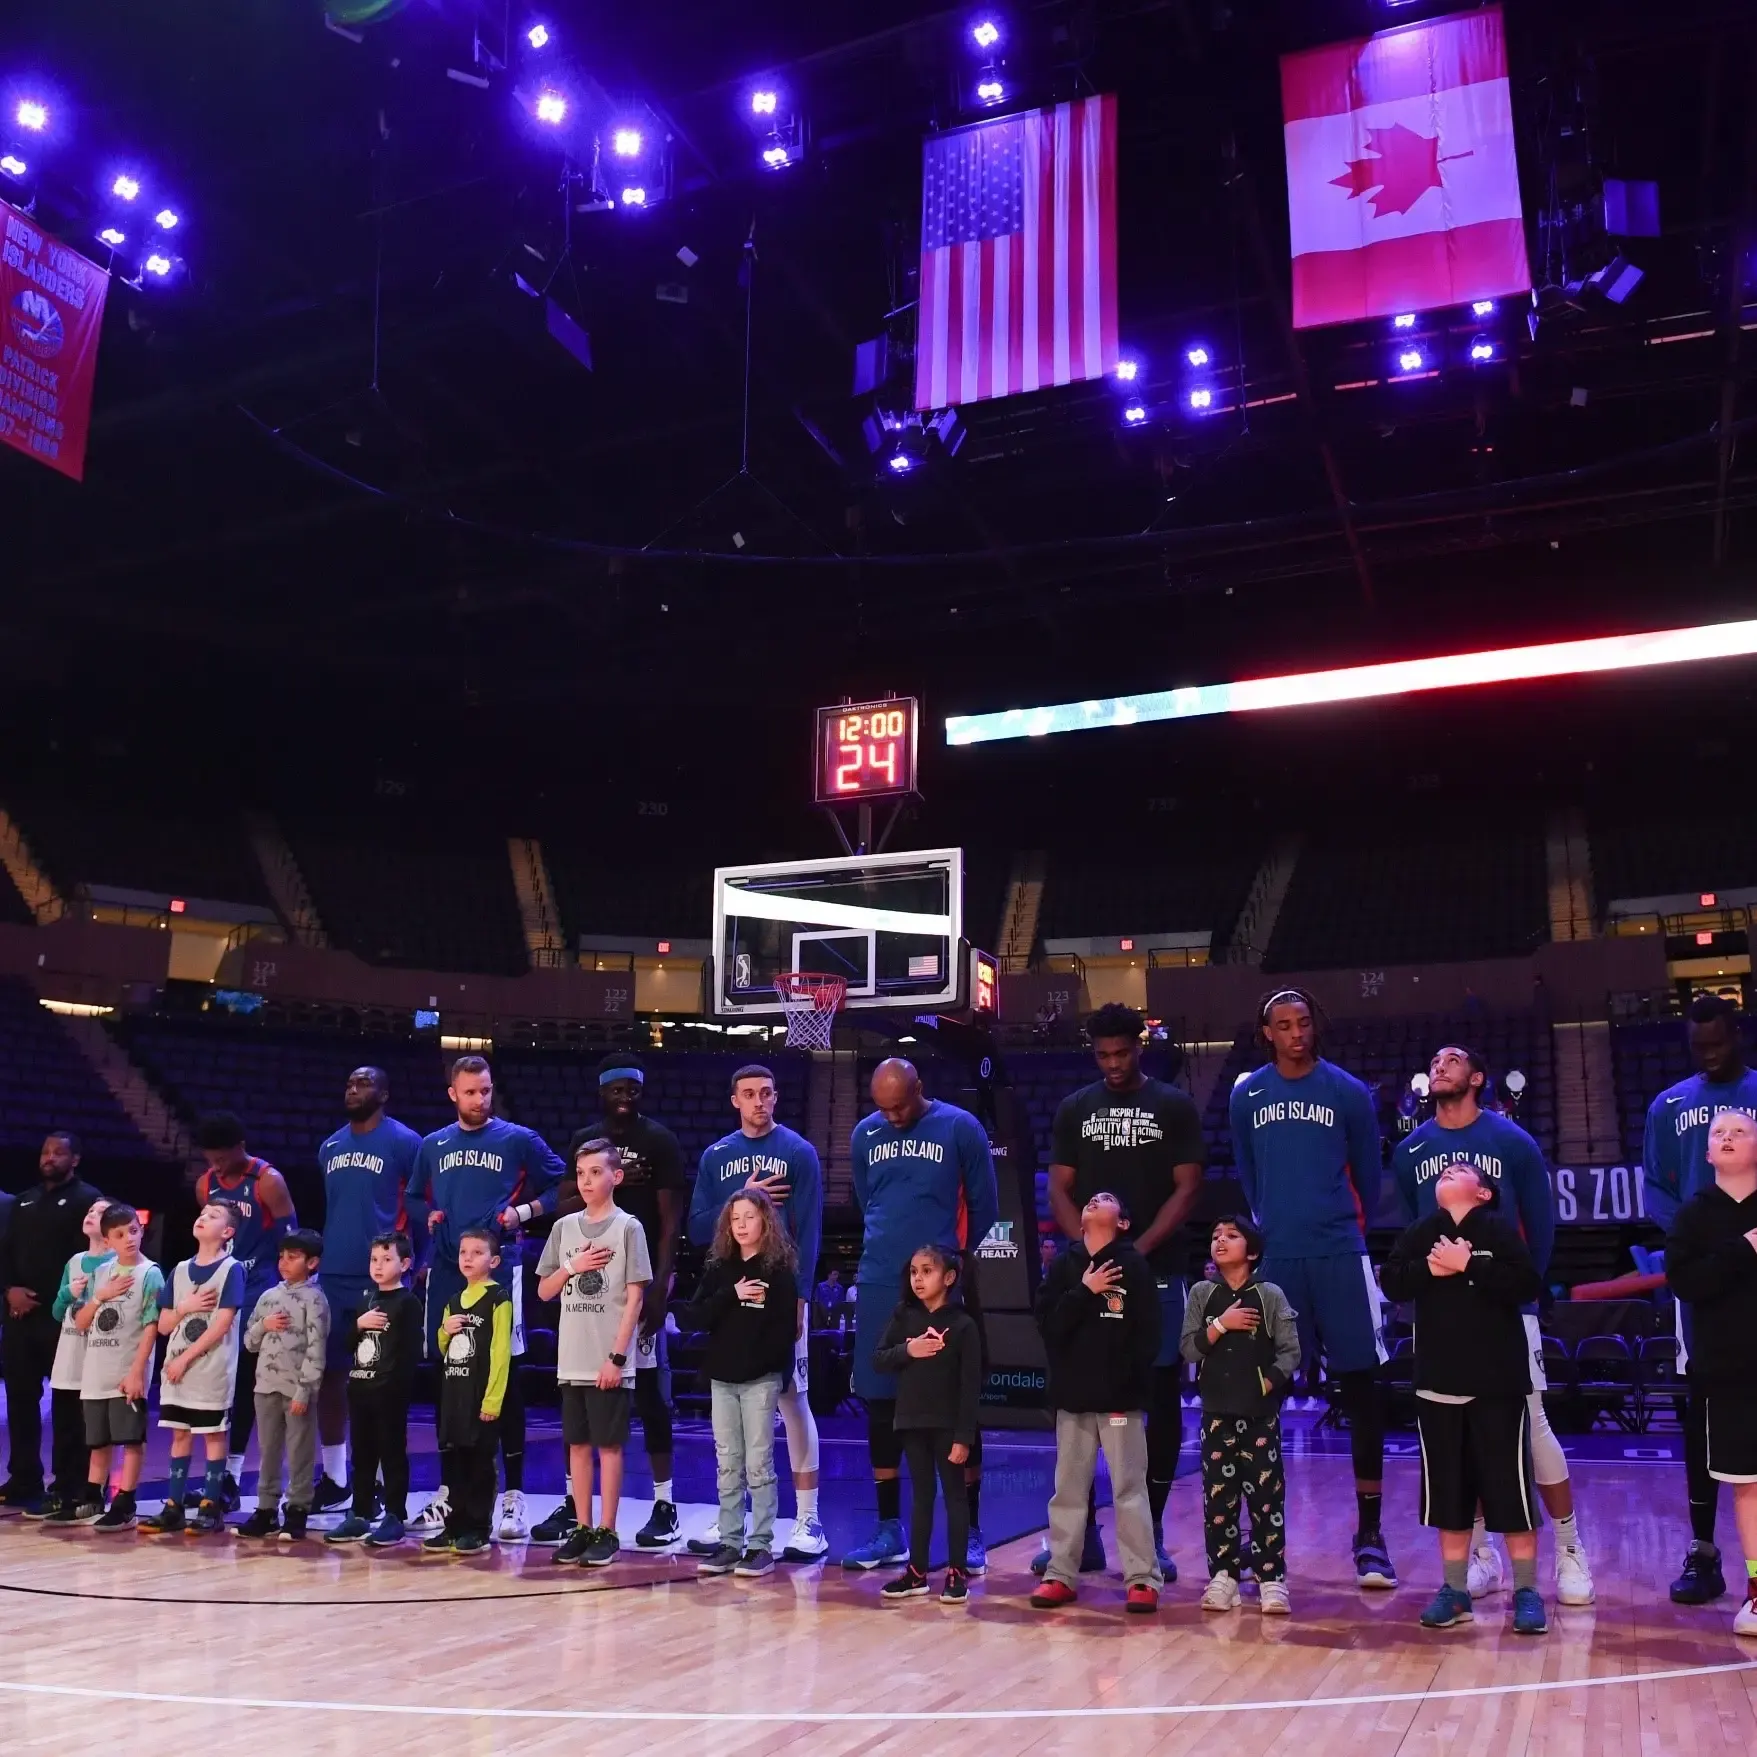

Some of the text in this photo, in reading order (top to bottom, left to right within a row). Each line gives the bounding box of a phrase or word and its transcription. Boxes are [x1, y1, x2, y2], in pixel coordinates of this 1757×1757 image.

[6, 215, 89, 288] NEW YORK
[2, 240, 86, 310] ISLANDERS
[3, 344, 60, 393] PATRICK
[0, 364, 58, 415] DIVISION
[0, 388, 65, 440] AMPIONS
[840, 711, 903, 742] 12:00
[837, 742, 895, 790] 24
[1109, 1107, 1135, 1118] INSPIRE
[1253, 1101, 1334, 1129] LONG ISLAND
[1675, 1106, 1709, 1136] LONG
[1082, 1122, 1121, 1138] EQUALITY
[1110, 1135, 1131, 1147] LOVE
[1137, 1127, 1163, 1140] ACTIVATE
[327, 1151, 384, 1174] LONG ISLAND
[439, 1149, 503, 1173] LONG ISLAND
[868, 1139, 944, 1166] LONG ISLAND
[720, 1154, 788, 1181] LONG ISLAND
[1415, 1153, 1448, 1184] LONG
[981, 1249, 1019, 1259] REALTY
